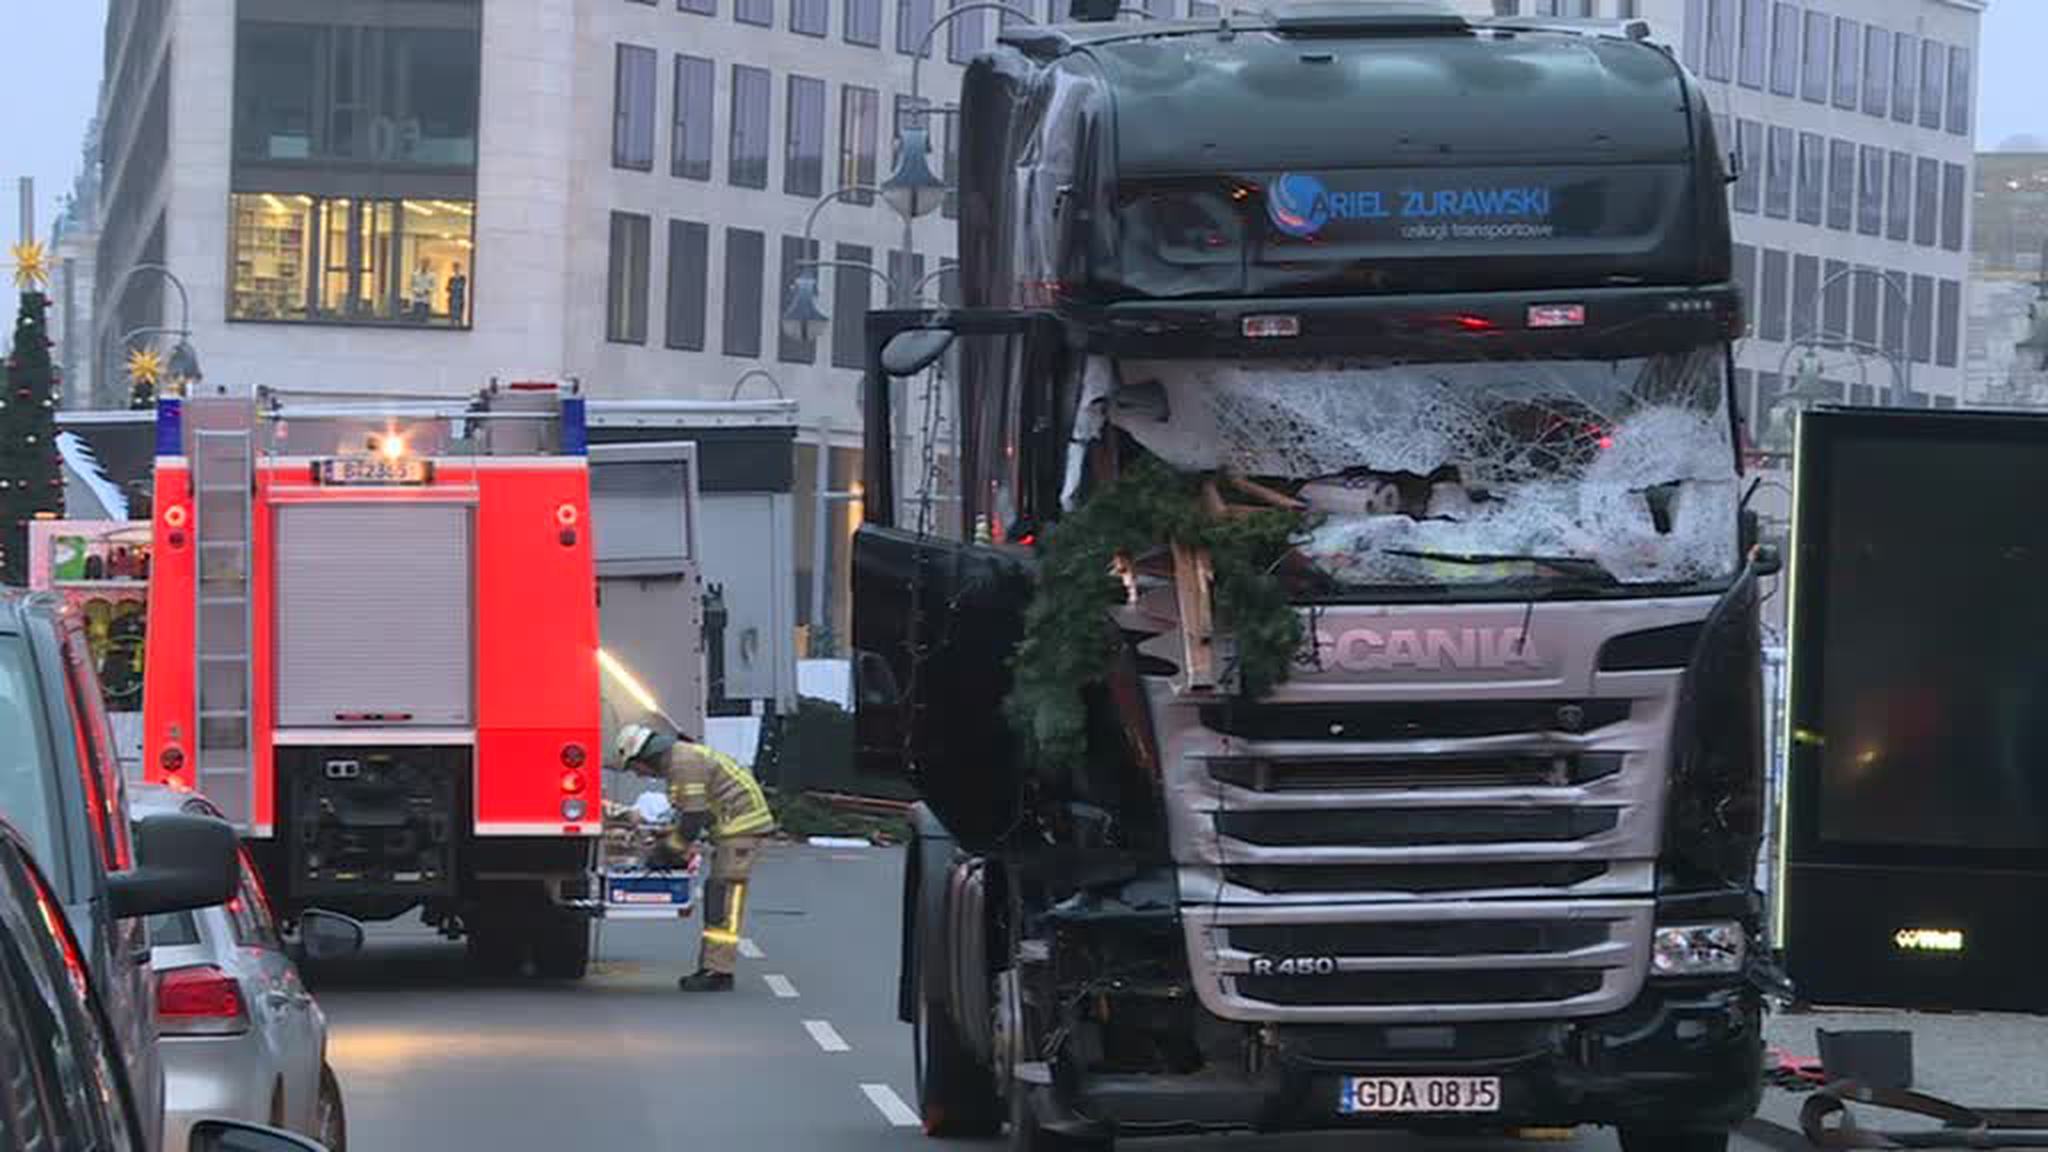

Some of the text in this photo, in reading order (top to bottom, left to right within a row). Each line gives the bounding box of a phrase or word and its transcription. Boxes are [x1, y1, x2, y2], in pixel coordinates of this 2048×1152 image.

[1310, 190, 1391, 218] ARIEL
[1253, 957, 1335, 975] R 450
[1357, 1080, 1416, 1107] GDA
